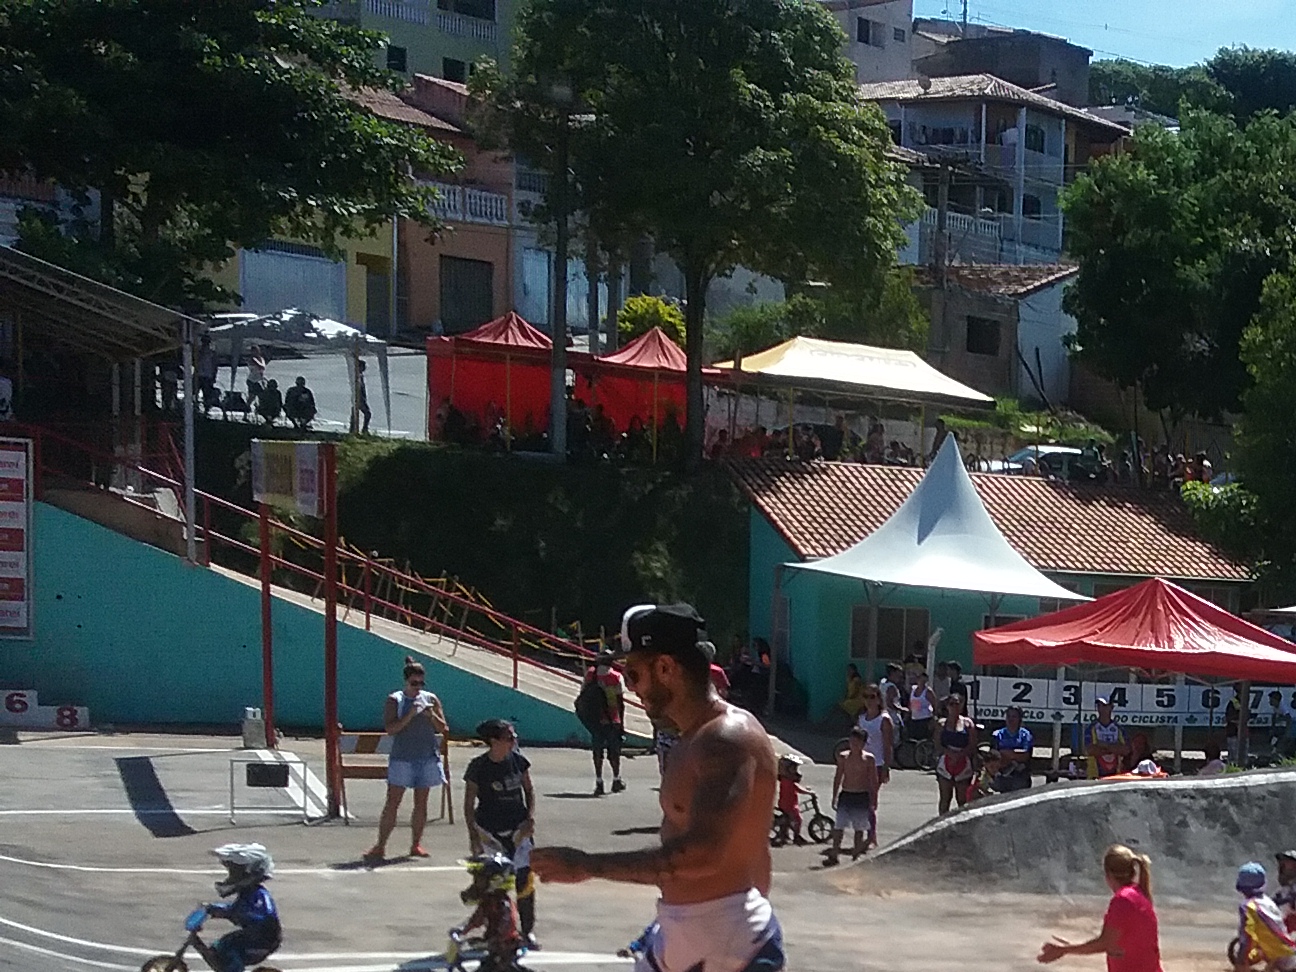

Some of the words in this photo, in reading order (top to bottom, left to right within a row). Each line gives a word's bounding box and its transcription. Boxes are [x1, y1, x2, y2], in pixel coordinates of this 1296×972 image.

[5, 692, 29, 713] 6
[1011, 682, 1033, 703] 2
[1062, 684, 1082, 705] 3
[1109, 687, 1129, 707] 4
[1155, 688, 1177, 708] 5
[1201, 689, 1222, 709] 6
[1249, 690, 1264, 709] 7
[56, 706, 79, 727] 8
[1131, 715, 1178, 724] CICLISTA
